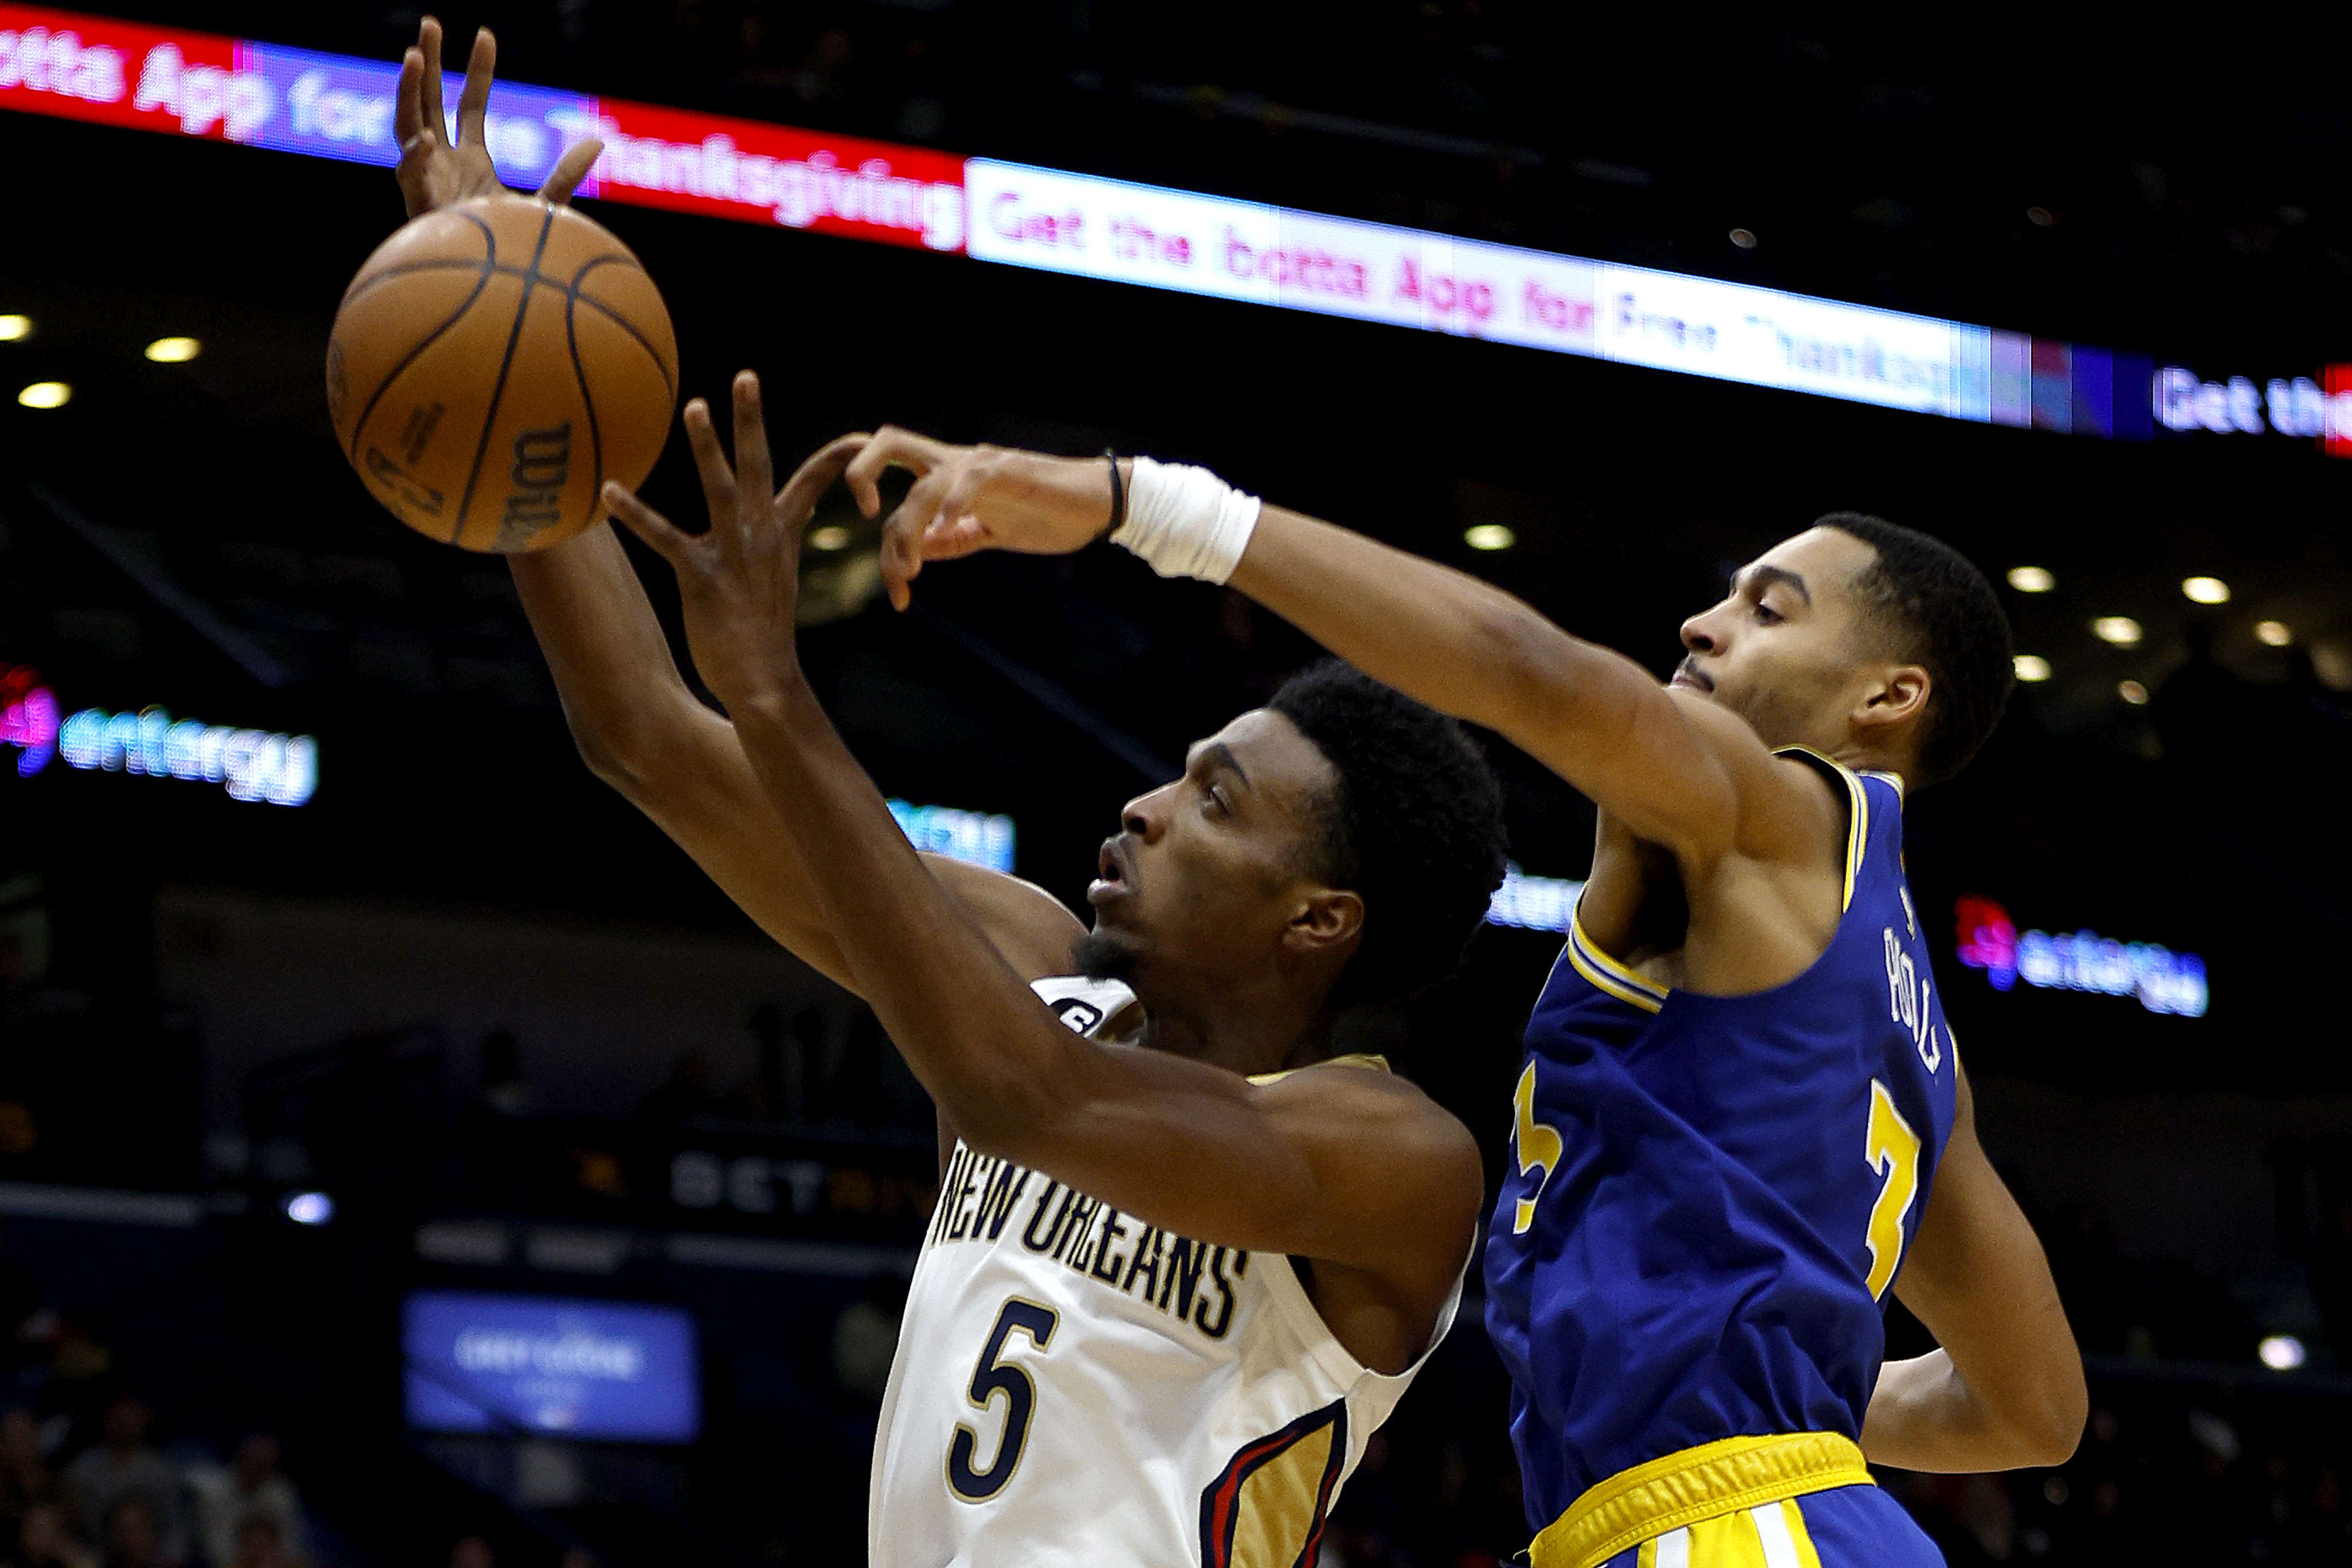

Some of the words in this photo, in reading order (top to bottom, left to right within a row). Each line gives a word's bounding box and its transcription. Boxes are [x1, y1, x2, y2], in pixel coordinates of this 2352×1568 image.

[133, 42, 273, 142] App
[288, 69, 397, 147] for
[547, 105, 965, 250] Thanksgiving
[989, 189, 1085, 254] Get
[1107, 209, 1197, 272] the
[1394, 256, 1498, 329] App
[1524, 275, 1595, 336] for
[2152, 365, 2265, 435] Get
[60, 706, 319, 807] entergy
[2017, 930, 2210, 1018] entergy
[933, 1145, 1031, 1245] NEW
[1020, 1178, 1249, 1340] ORLEANS
[944, 1295, 1060, 1505] 5
